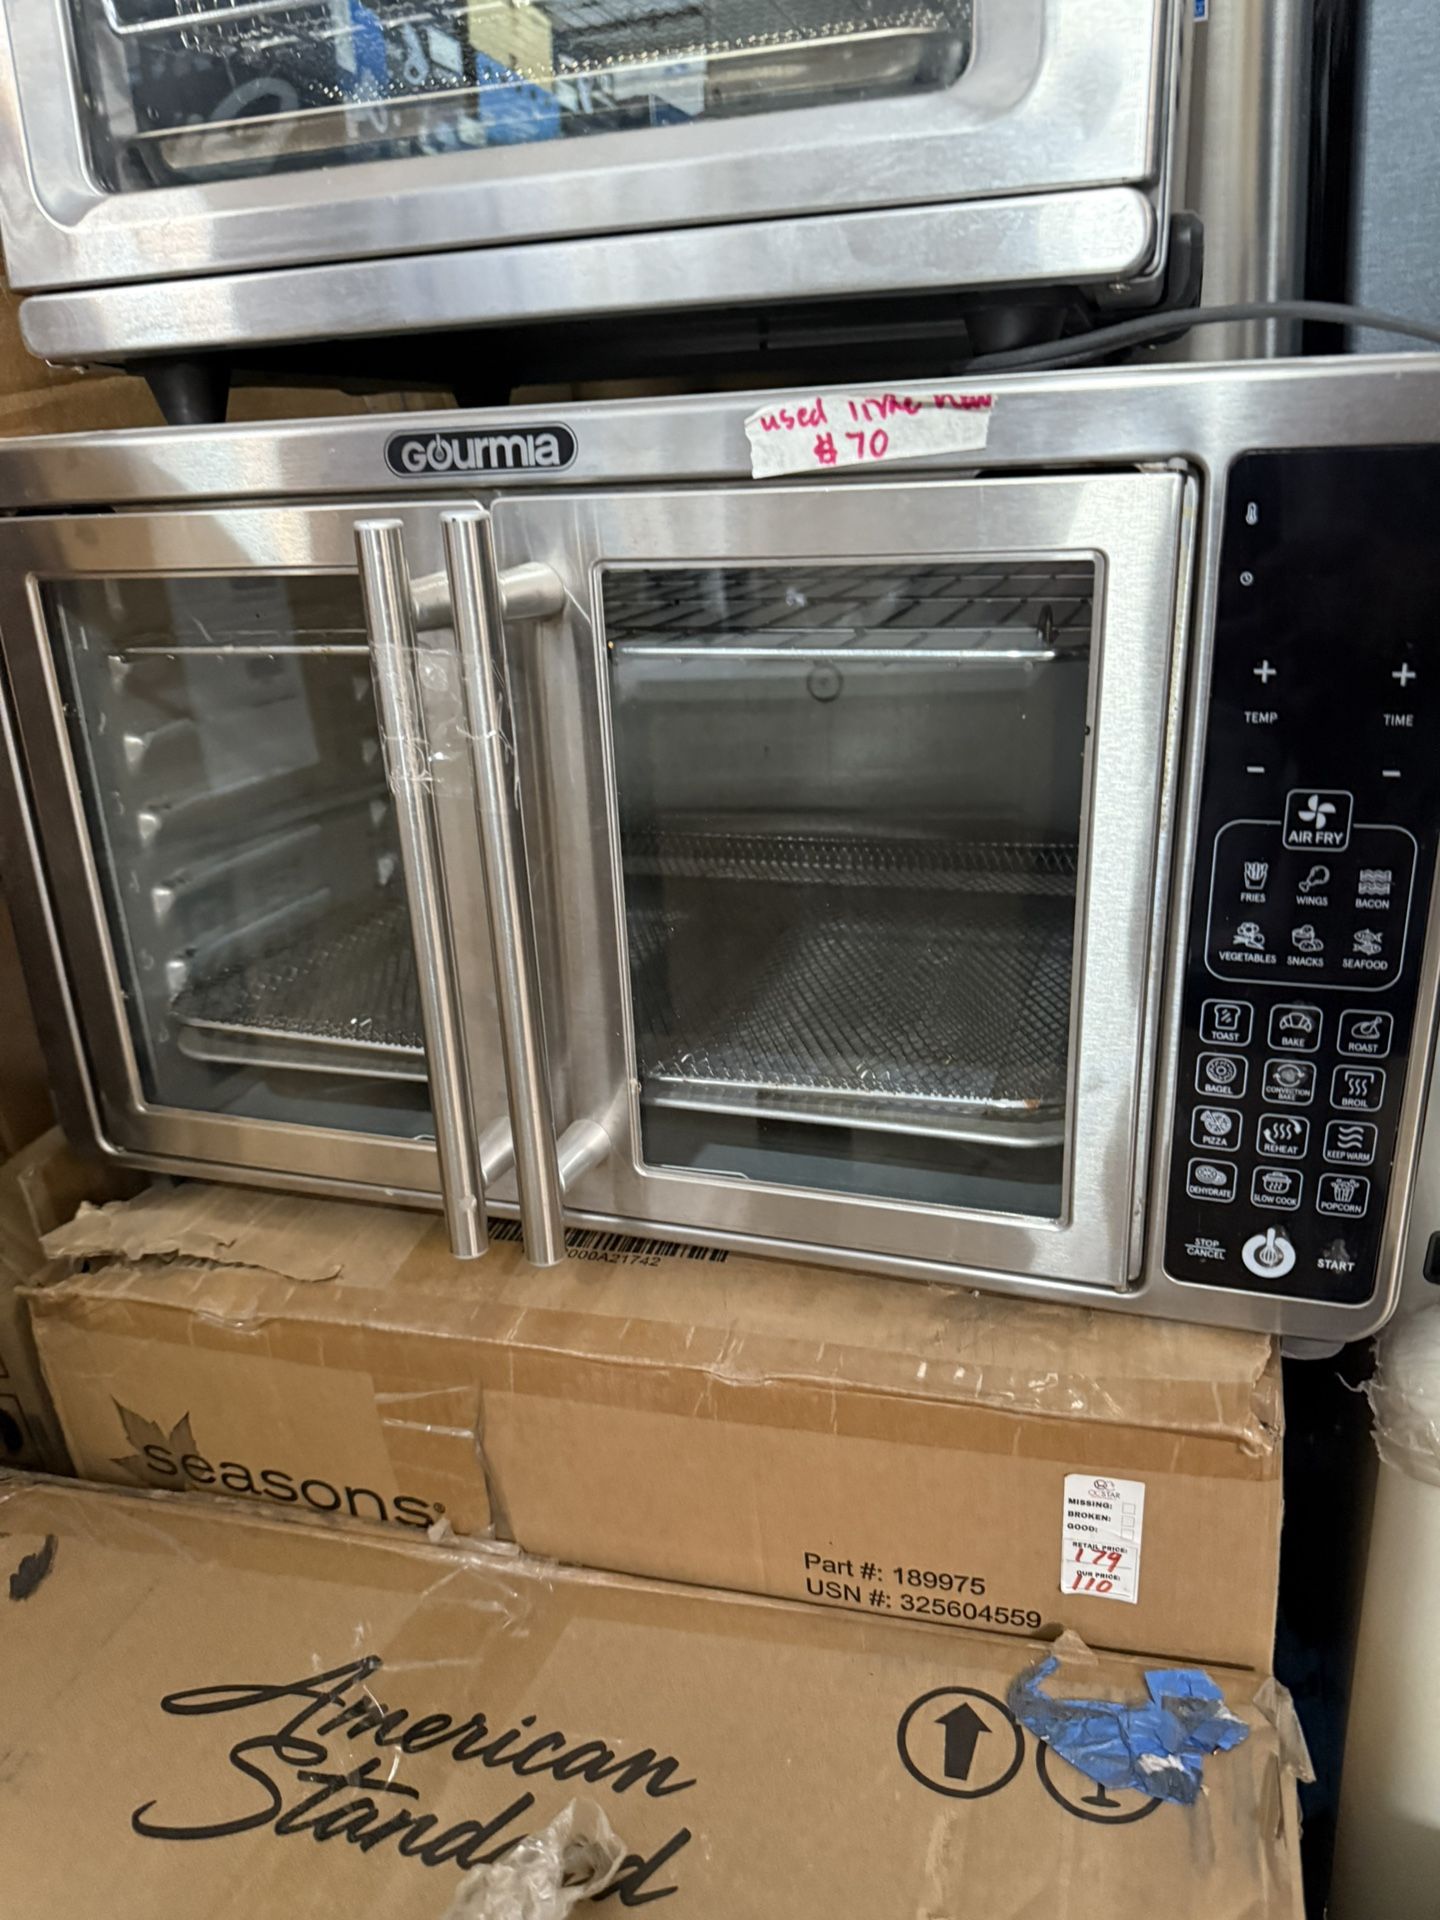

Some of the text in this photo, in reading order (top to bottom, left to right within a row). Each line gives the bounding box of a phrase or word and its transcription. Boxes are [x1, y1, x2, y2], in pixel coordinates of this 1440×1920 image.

[760, 396, 827, 432] used
[401, 433, 560, 473] Gourmia
[1245, 711, 1277, 723] TEMP
[1383, 714, 1413, 727] TIME
[1288, 830, 1343, 845] AIR FRY
[1241, 893, 1266, 902] FRIES
[1296, 896, 1328, 906] WINGS
[1355, 899, 1389, 910] BACON
[1219, 951, 1276, 965] VEGETABLES
[1287, 956, 1324, 967] SNACKS
[1342, 958, 1388, 970] SEAFOOD
[1212, 1030, 1239, 1041] TOAST
[1281, 1037, 1305, 1047] BAKE
[1349, 1042, 1378, 1053] ROAST
[1205, 1084, 1233, 1095] BAGEL
[1266, 1086, 1311, 1096] CONVECTION
[1341, 1097, 1368, 1108] BROIL
[1202, 1135, 1228, 1146] PIZZA
[1263, 1143, 1298, 1155] REHEAT
[1327, 1150, 1371, 1162] KEEP WARM
[1189, 1185, 1232, 1198] DEHYDRATE
[1253, 1193, 1297, 1206] SLOW COOK
[1320, 1202, 1362, 1213] POPCORN
[1194, 1237, 1220, 1247] STOP
[1186, 1248, 1226, 1260] CANCEL
[1317, 1258, 1355, 1272] START
[1068, 1498, 1112, 1510] MISSING:
[1067, 1511, 1111, 1522] BROKEN:
[1067, 1523, 1098, 1533] GOOD:
[804, 1552, 986, 1596] Part #: 189975
[806, 1577, 1042, 1629] USN #: 325604559
[161, 1654, 697, 1798] American
[131, 1734, 691, 1907] Standd
